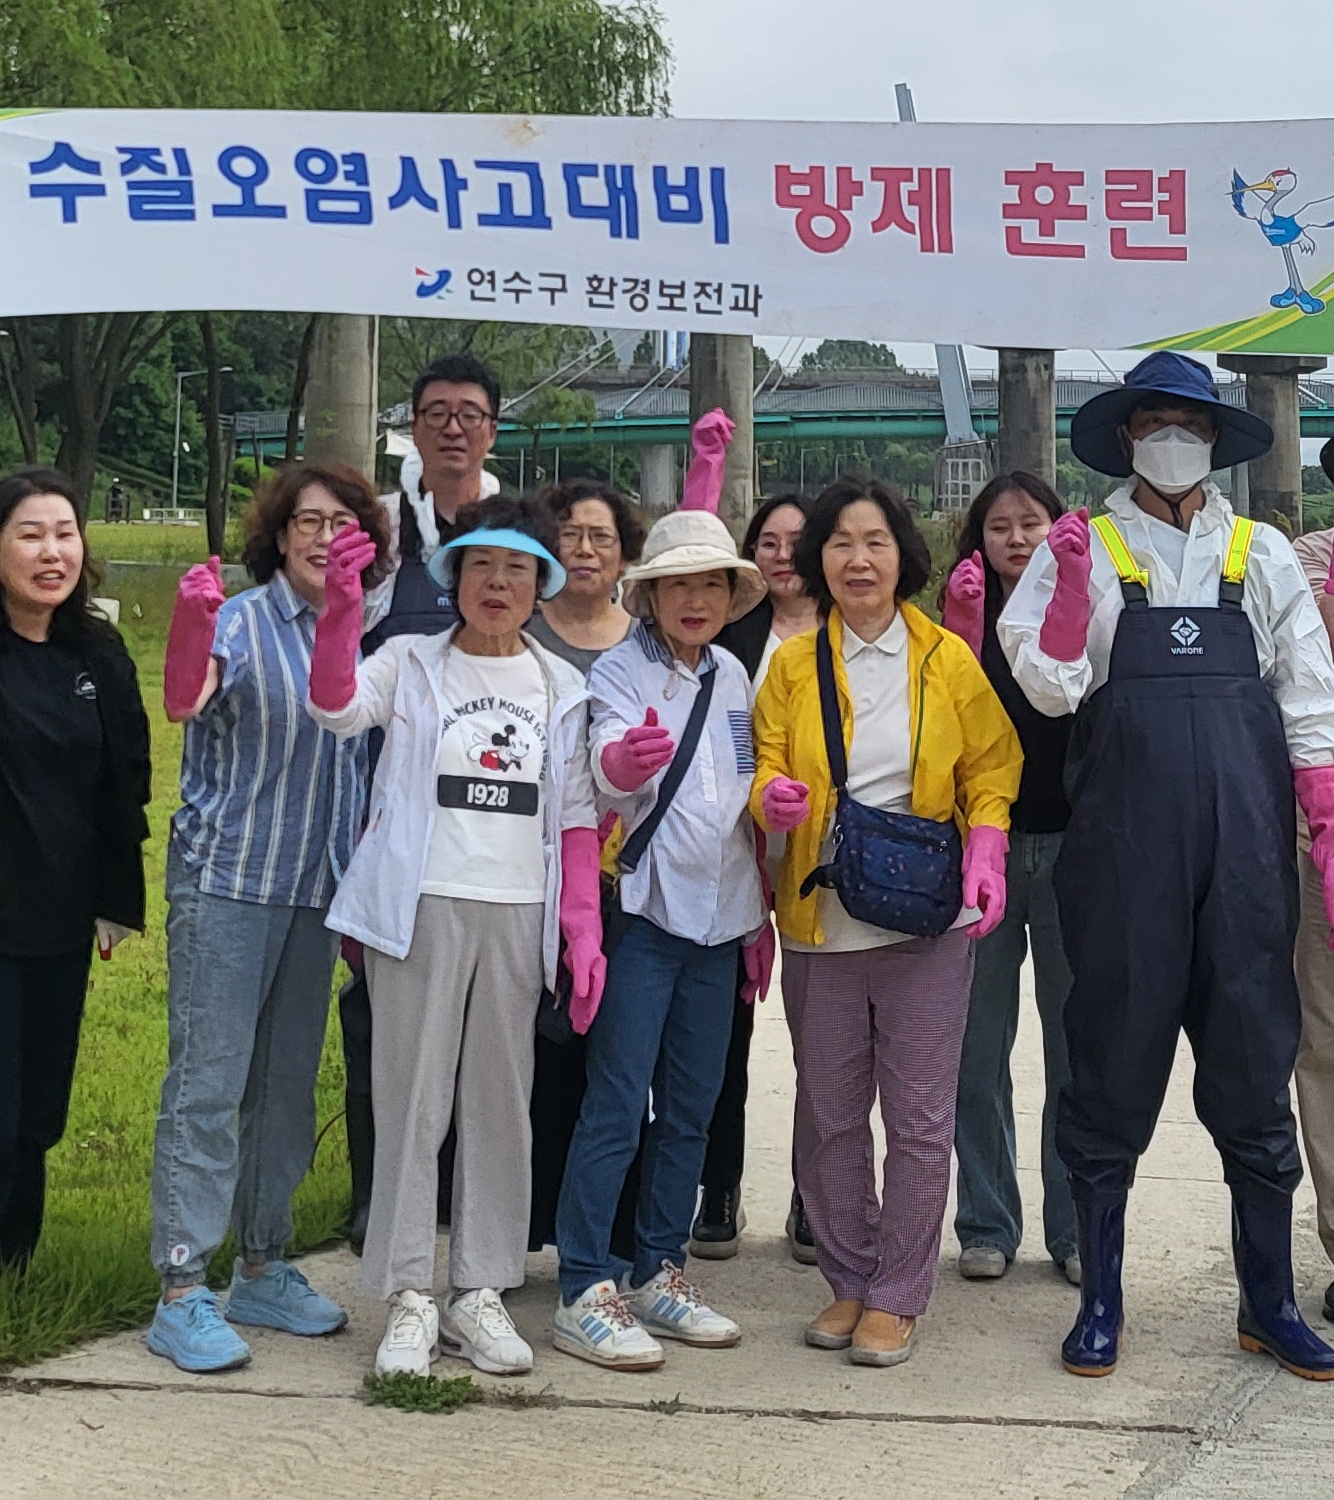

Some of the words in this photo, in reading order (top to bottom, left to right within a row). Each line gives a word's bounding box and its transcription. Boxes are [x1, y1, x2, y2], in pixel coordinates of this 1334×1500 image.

[27, 141, 730, 246] 수질오염사고대비
[774, 164, 953, 254] 방제
[1002, 162, 1187, 261] 훈련
[467, 267, 568, 306] 연수구
[585, 274, 763, 317] 환경보전과
[467, 782, 509, 807] 1928
